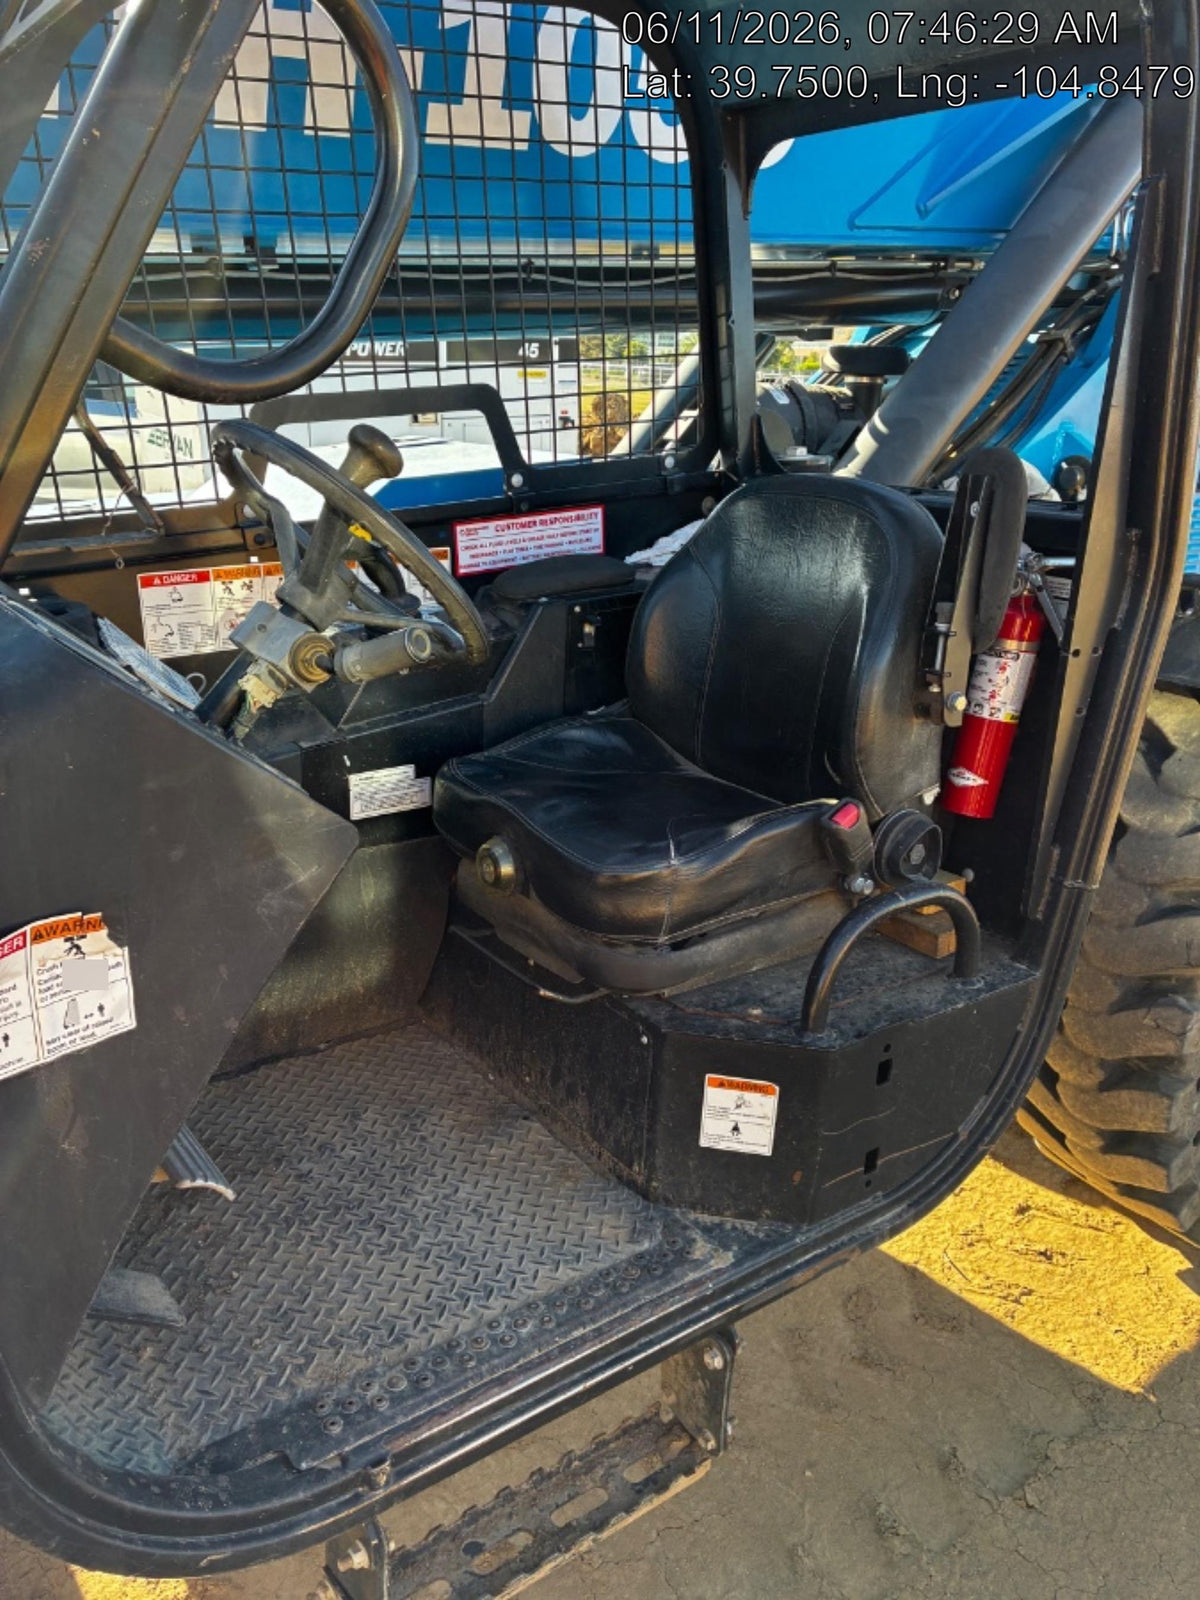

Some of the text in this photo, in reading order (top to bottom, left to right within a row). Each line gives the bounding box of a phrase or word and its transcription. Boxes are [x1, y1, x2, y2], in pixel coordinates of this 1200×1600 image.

[495, 520, 538, 532] CUSTOMER
[539, 512, 598, 526] RESPONSIBILITY
[162, 573, 198, 584] DANGER
